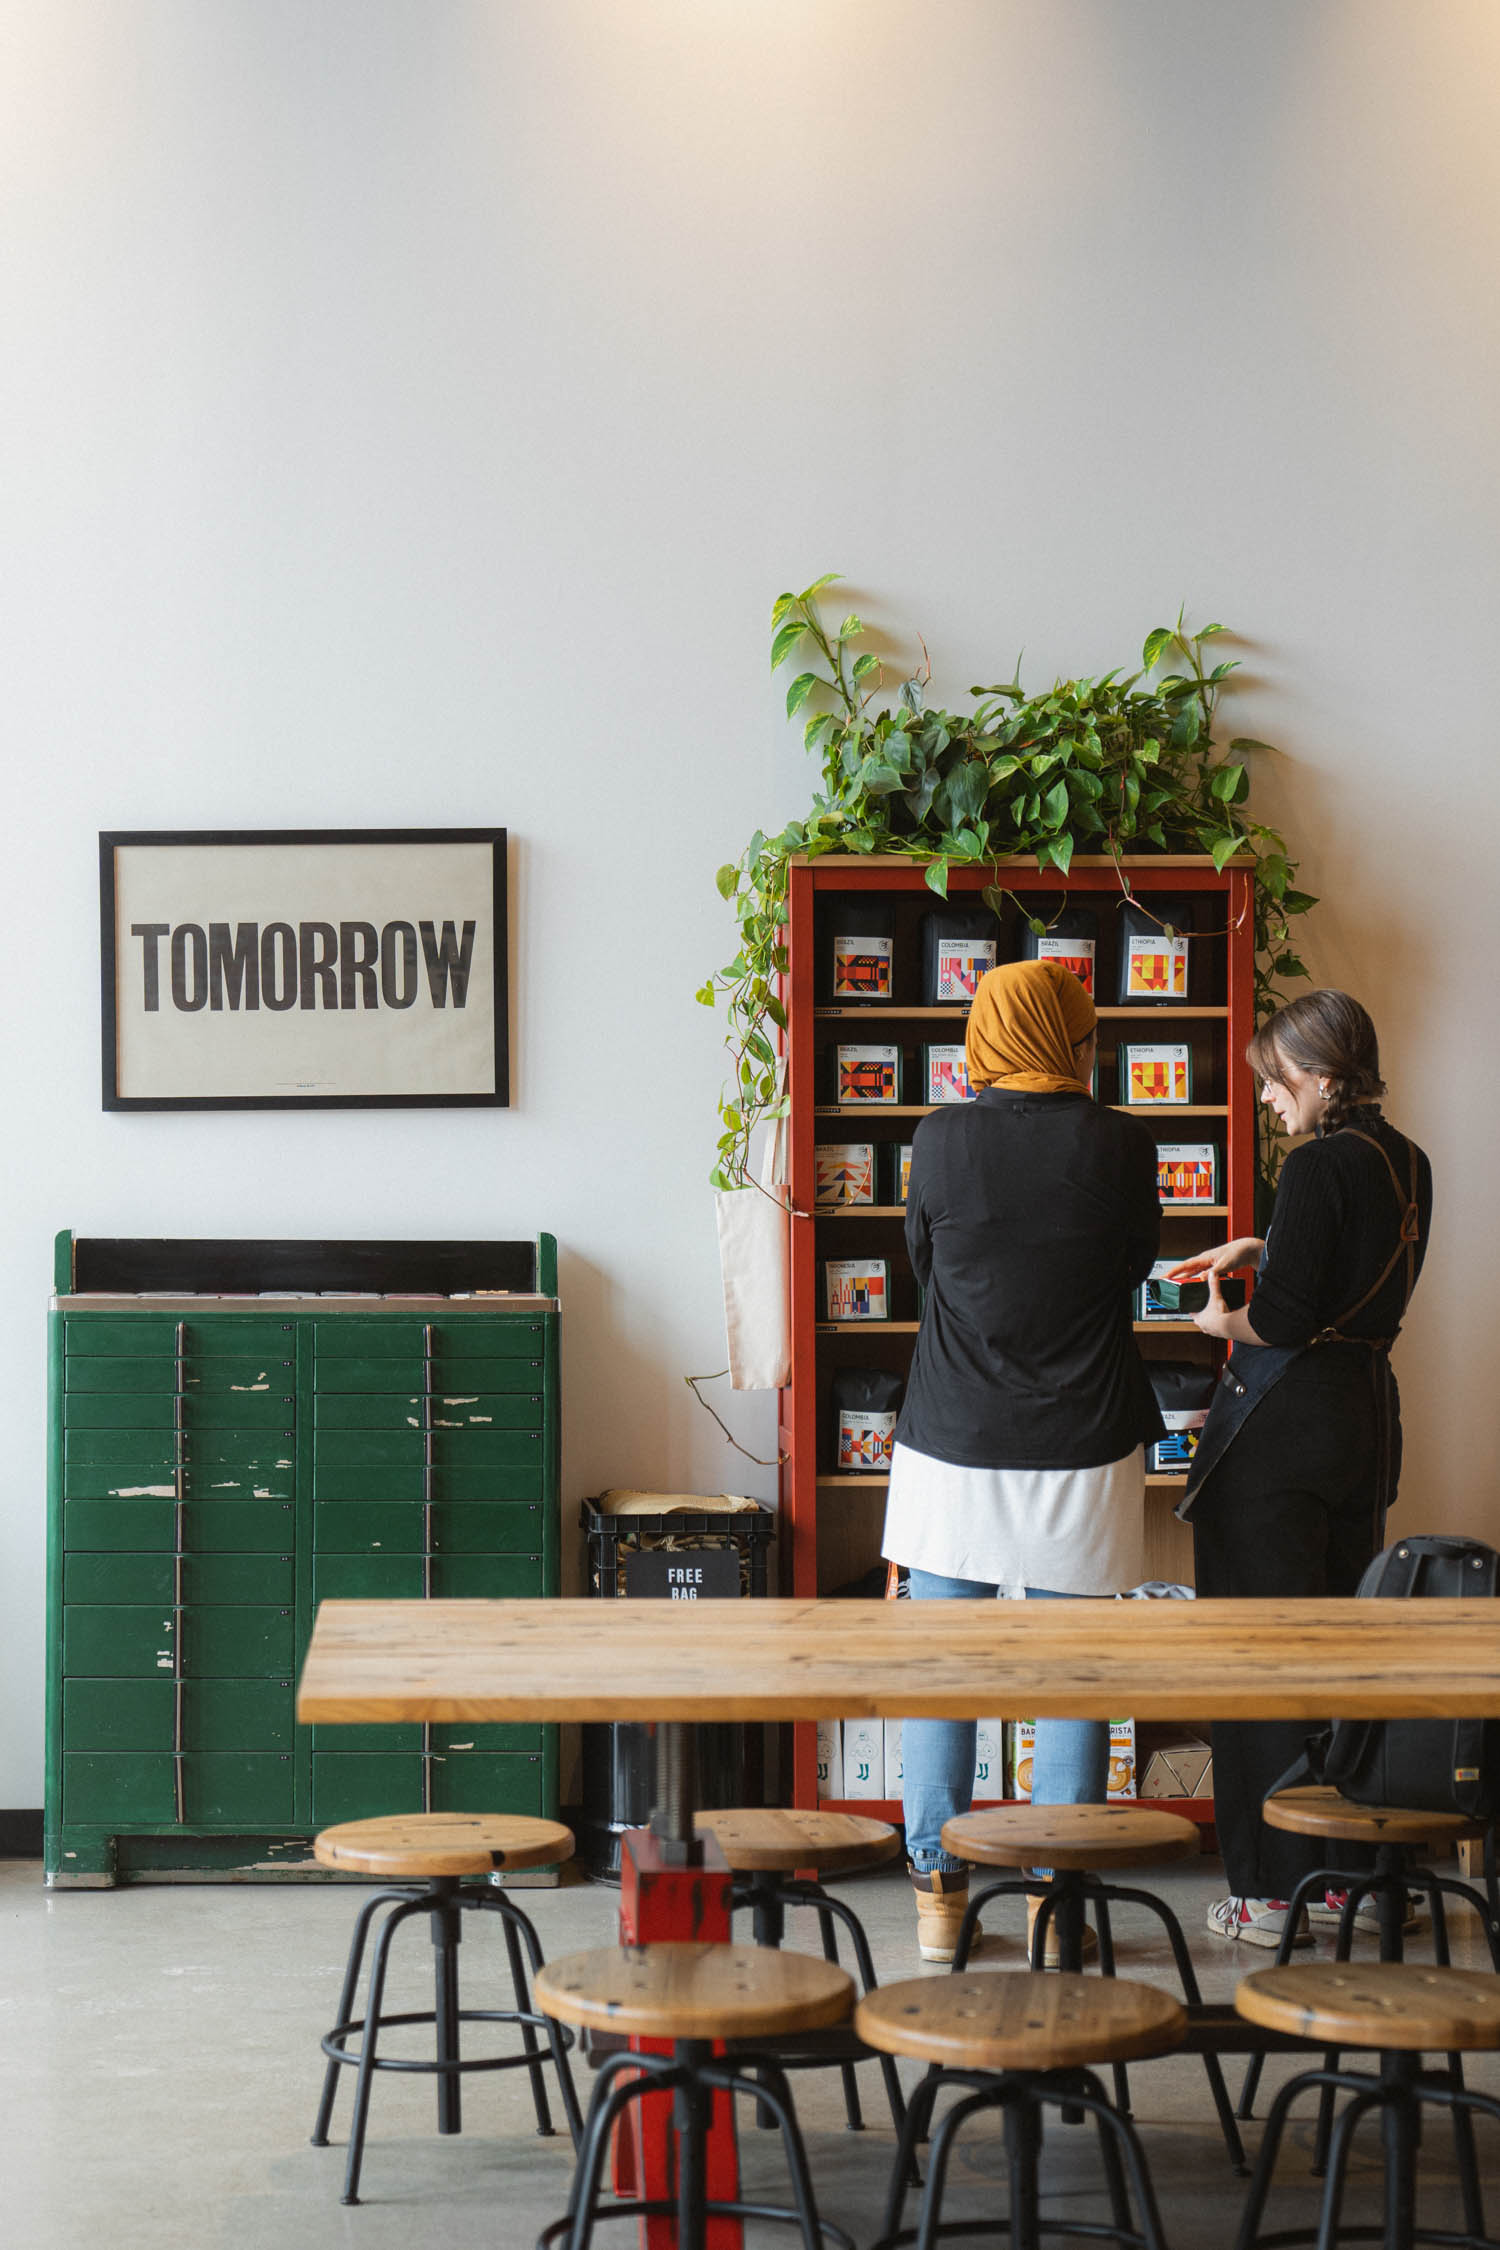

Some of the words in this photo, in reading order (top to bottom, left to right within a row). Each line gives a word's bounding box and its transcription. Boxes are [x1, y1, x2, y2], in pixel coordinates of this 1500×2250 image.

[131, 920, 477, 1012] TOMORROW
[842, 1412, 870, 1420] COLOMBIA
[668, 1568, 703, 1583] FREE
[672, 1587, 697, 1601] BAG
[1110, 1727, 1132, 1735] RISTA
